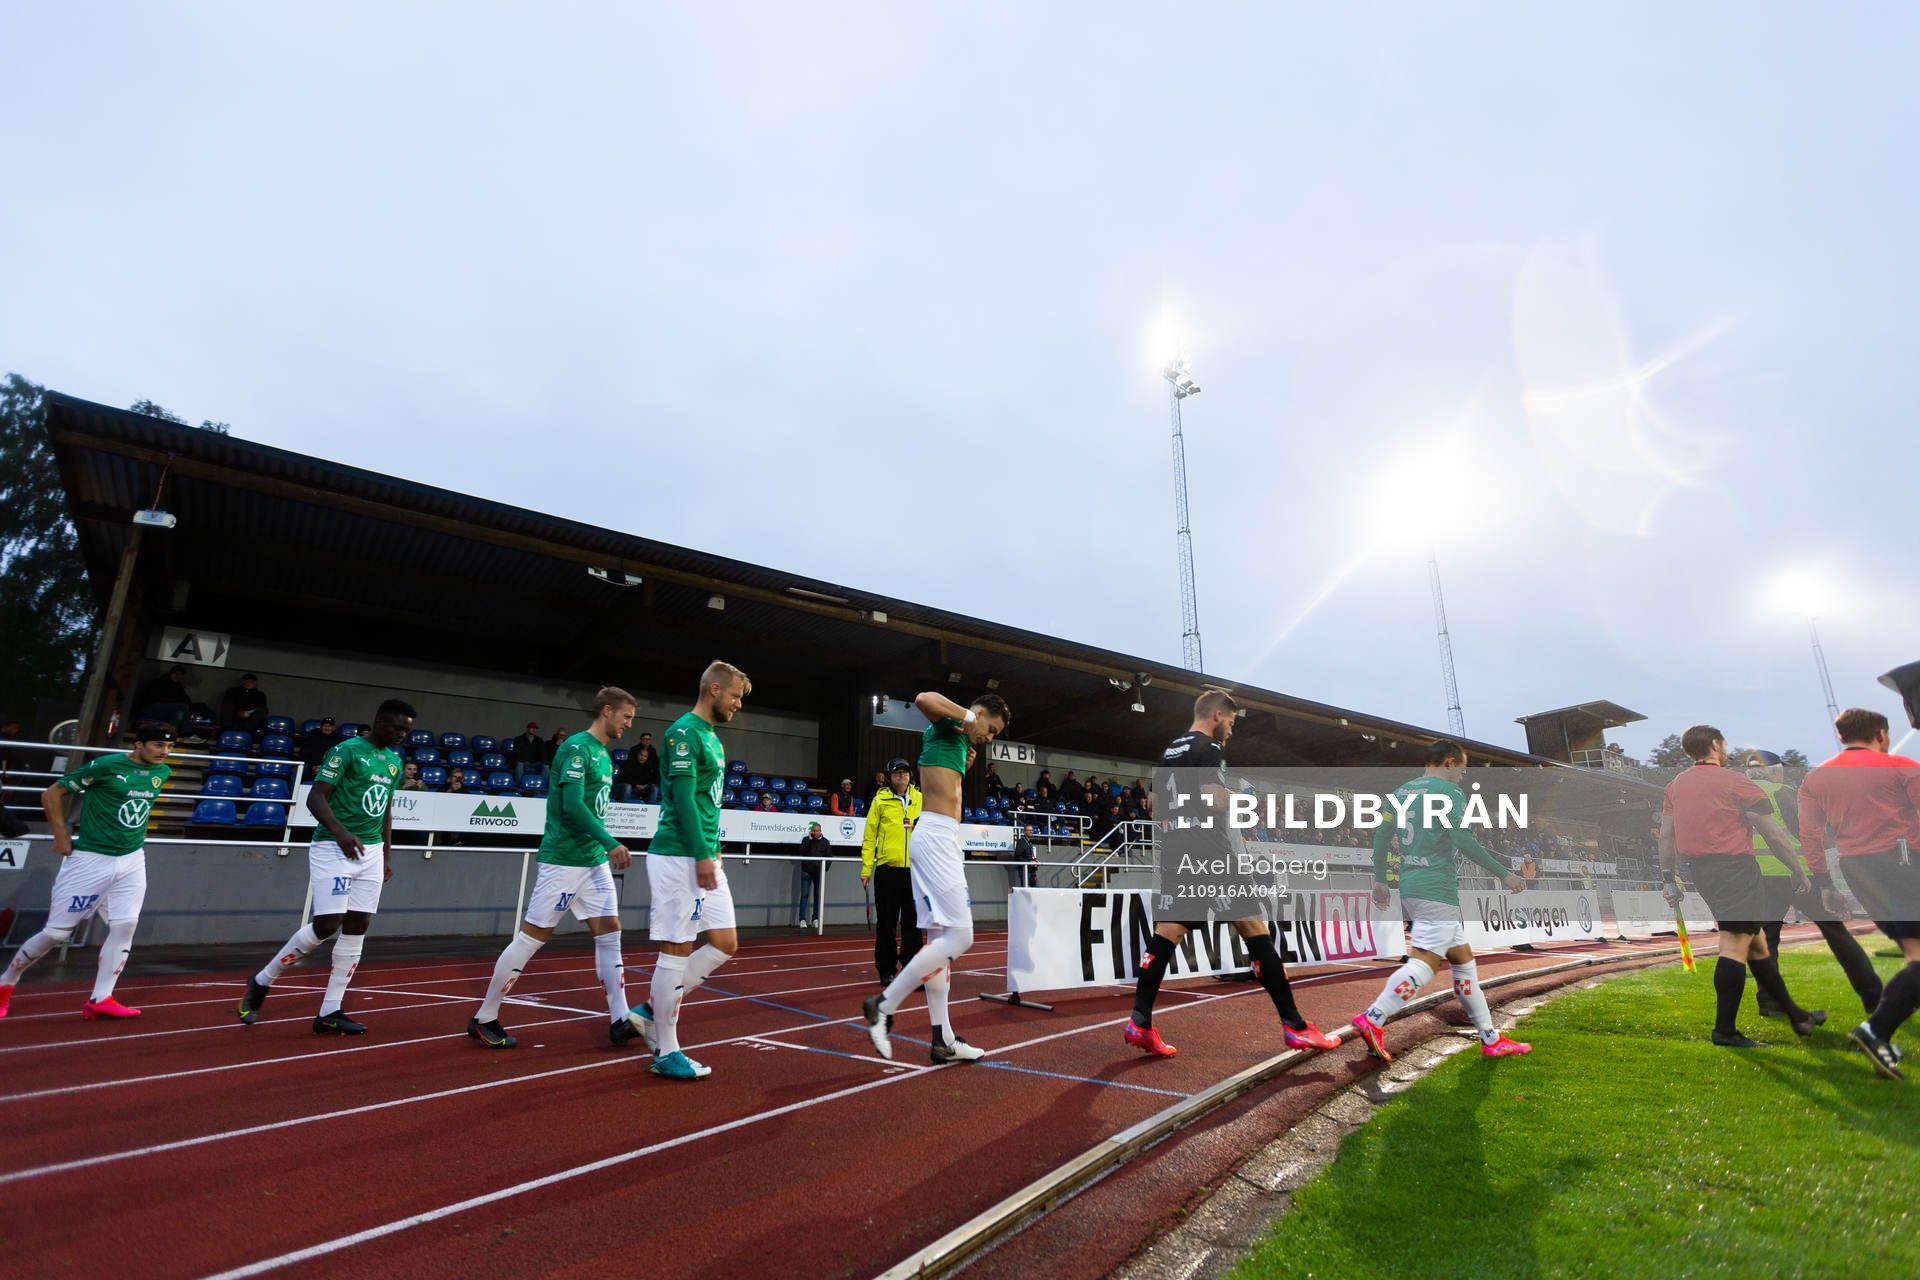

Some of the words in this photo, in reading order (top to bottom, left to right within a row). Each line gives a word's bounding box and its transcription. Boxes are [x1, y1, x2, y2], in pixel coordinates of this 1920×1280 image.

[171, 633, 203, 661] A
[1000, 744, 1011, 760] A
[1017, 745, 1027, 760] B
[469, 817, 518, 827] ERIWOOD
[750, 822, 807, 833] Finnvedsbostäder
